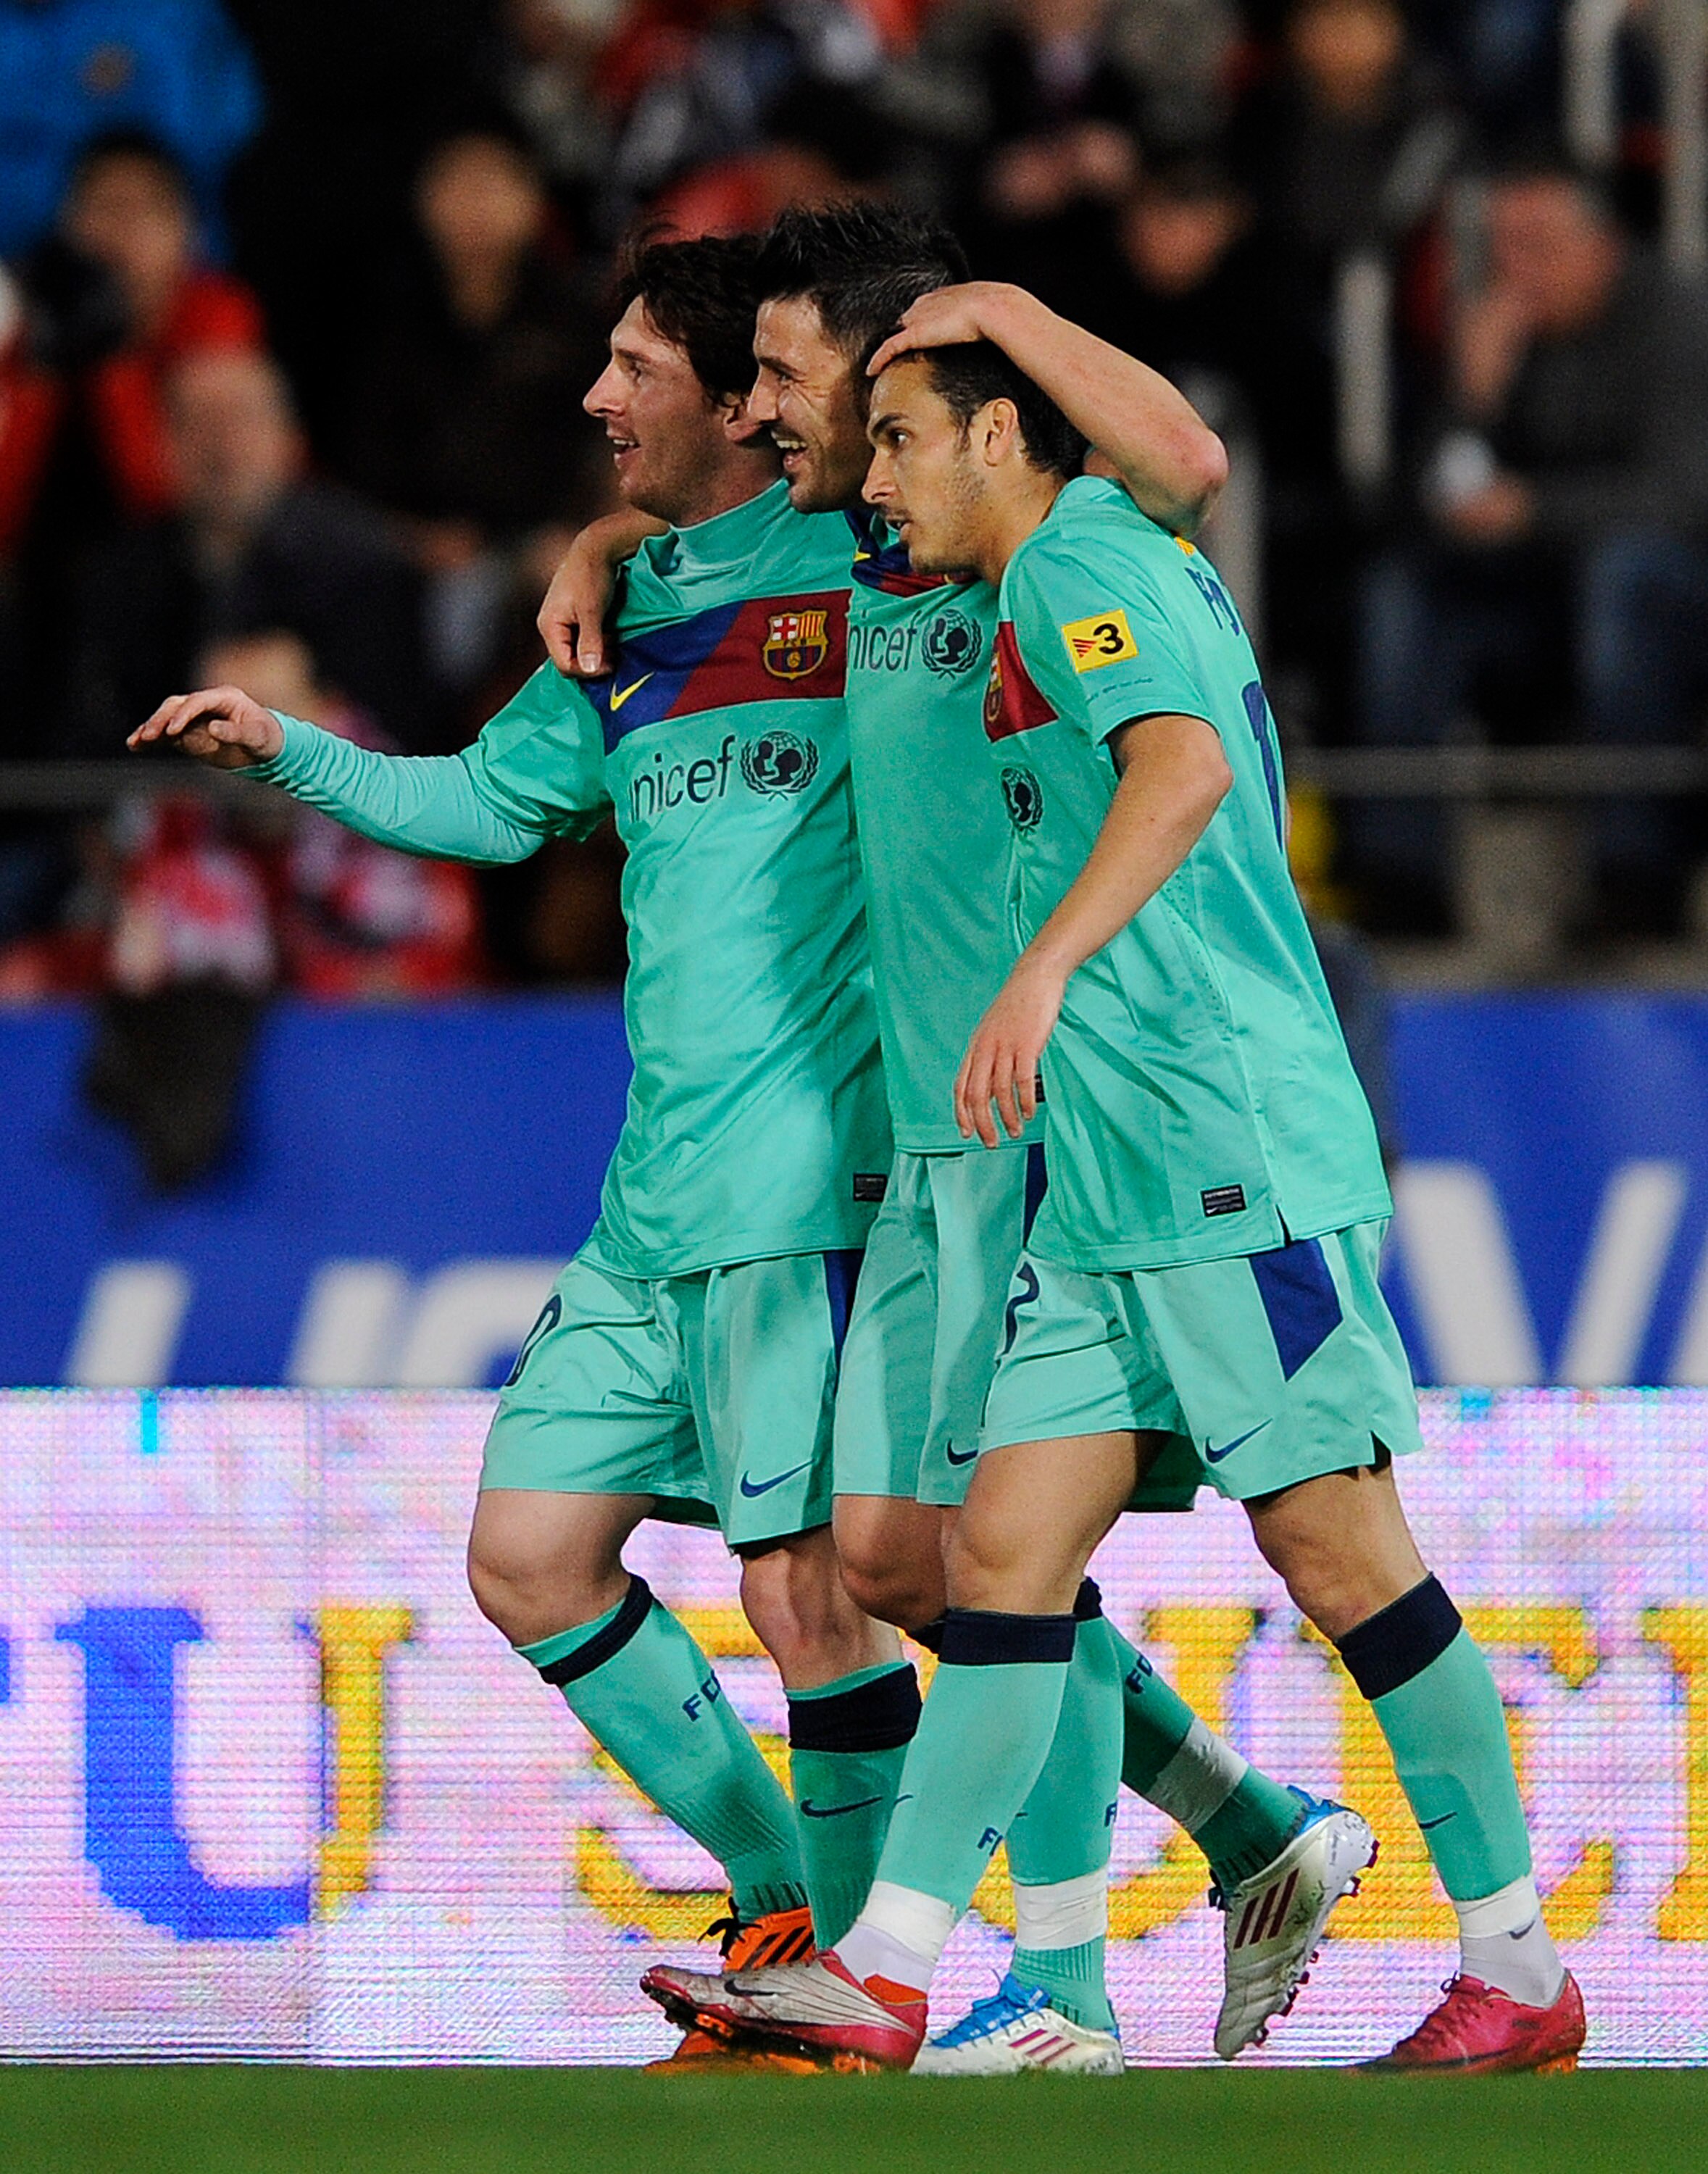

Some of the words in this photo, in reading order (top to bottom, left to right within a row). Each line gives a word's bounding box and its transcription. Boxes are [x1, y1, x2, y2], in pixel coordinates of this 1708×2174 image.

[848, 610, 922, 672] nicef
[1093, 622, 1125, 654] 3
[628, 734, 736, 823] nicef
[681, 1668, 722, 1723] FC
